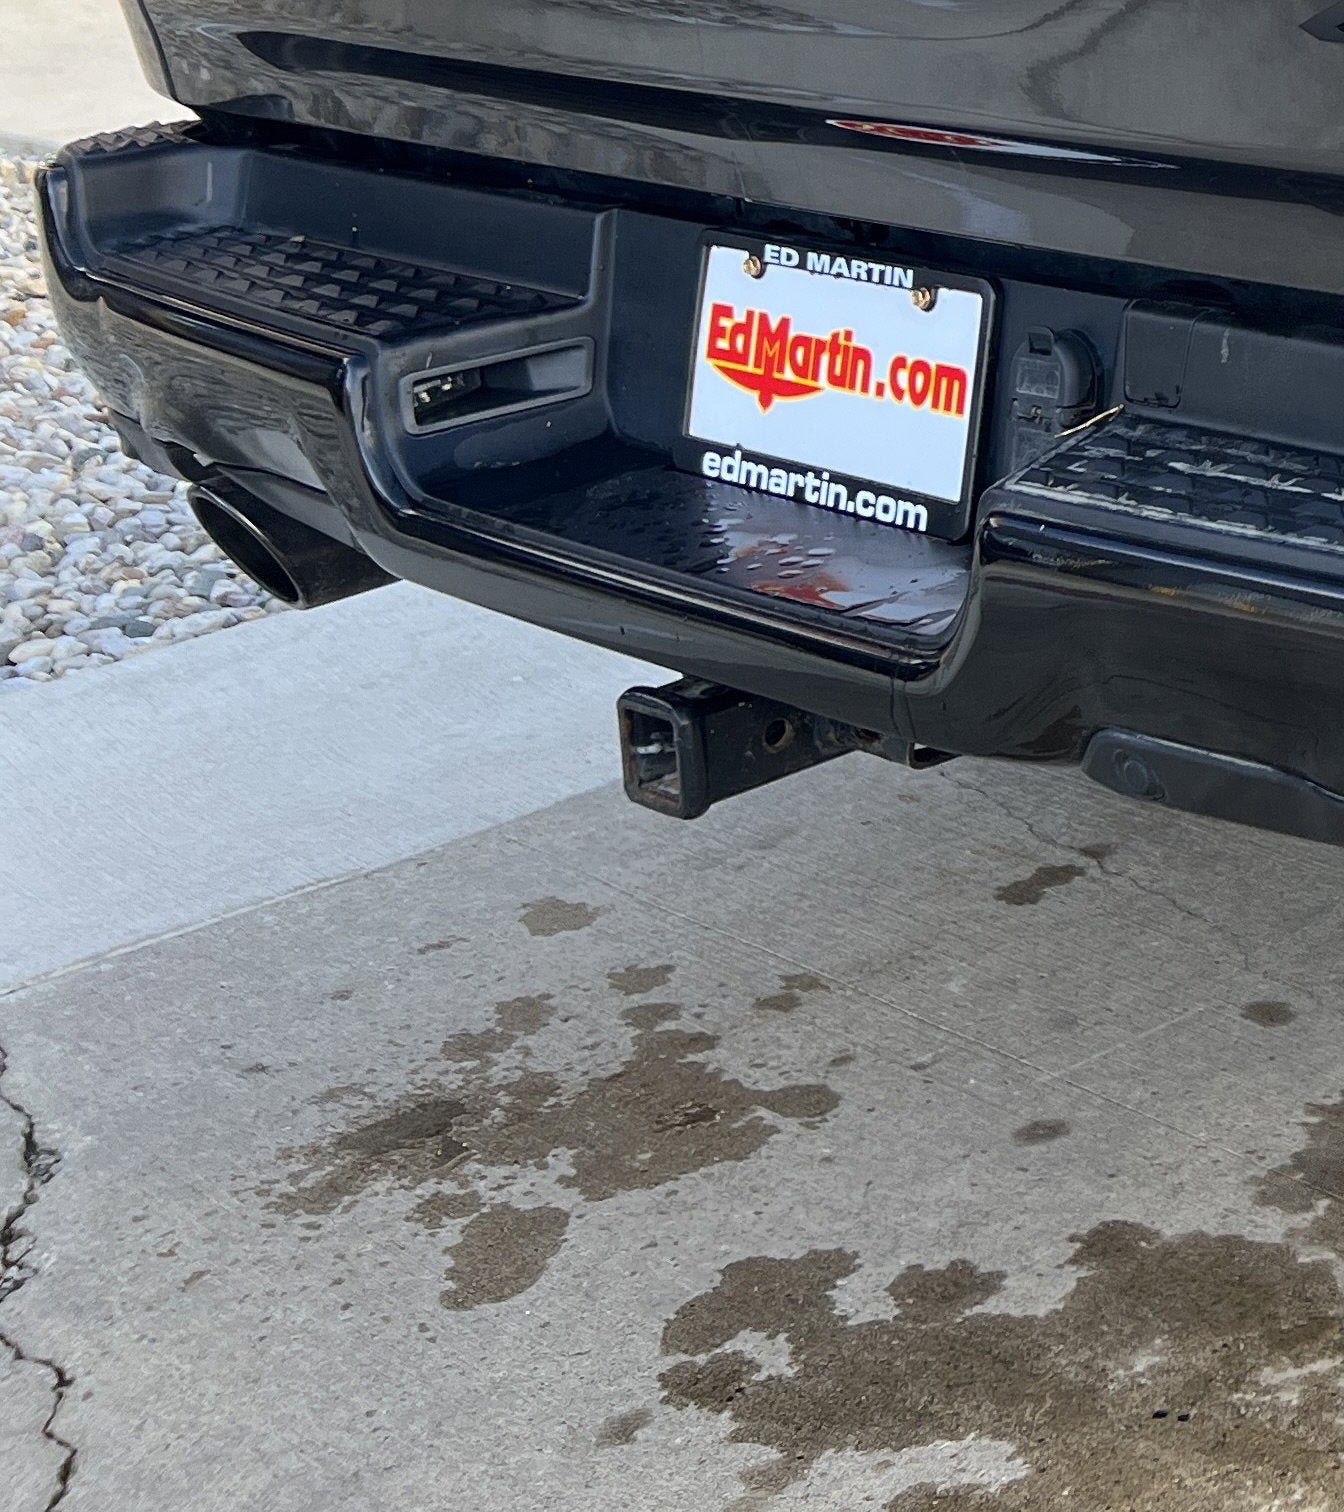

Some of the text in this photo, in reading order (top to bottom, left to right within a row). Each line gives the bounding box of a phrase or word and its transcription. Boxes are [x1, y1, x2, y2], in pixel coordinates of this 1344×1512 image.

[763, 243, 914, 289] ED MARTIN
[702, 449, 928, 533] edmartin.com
